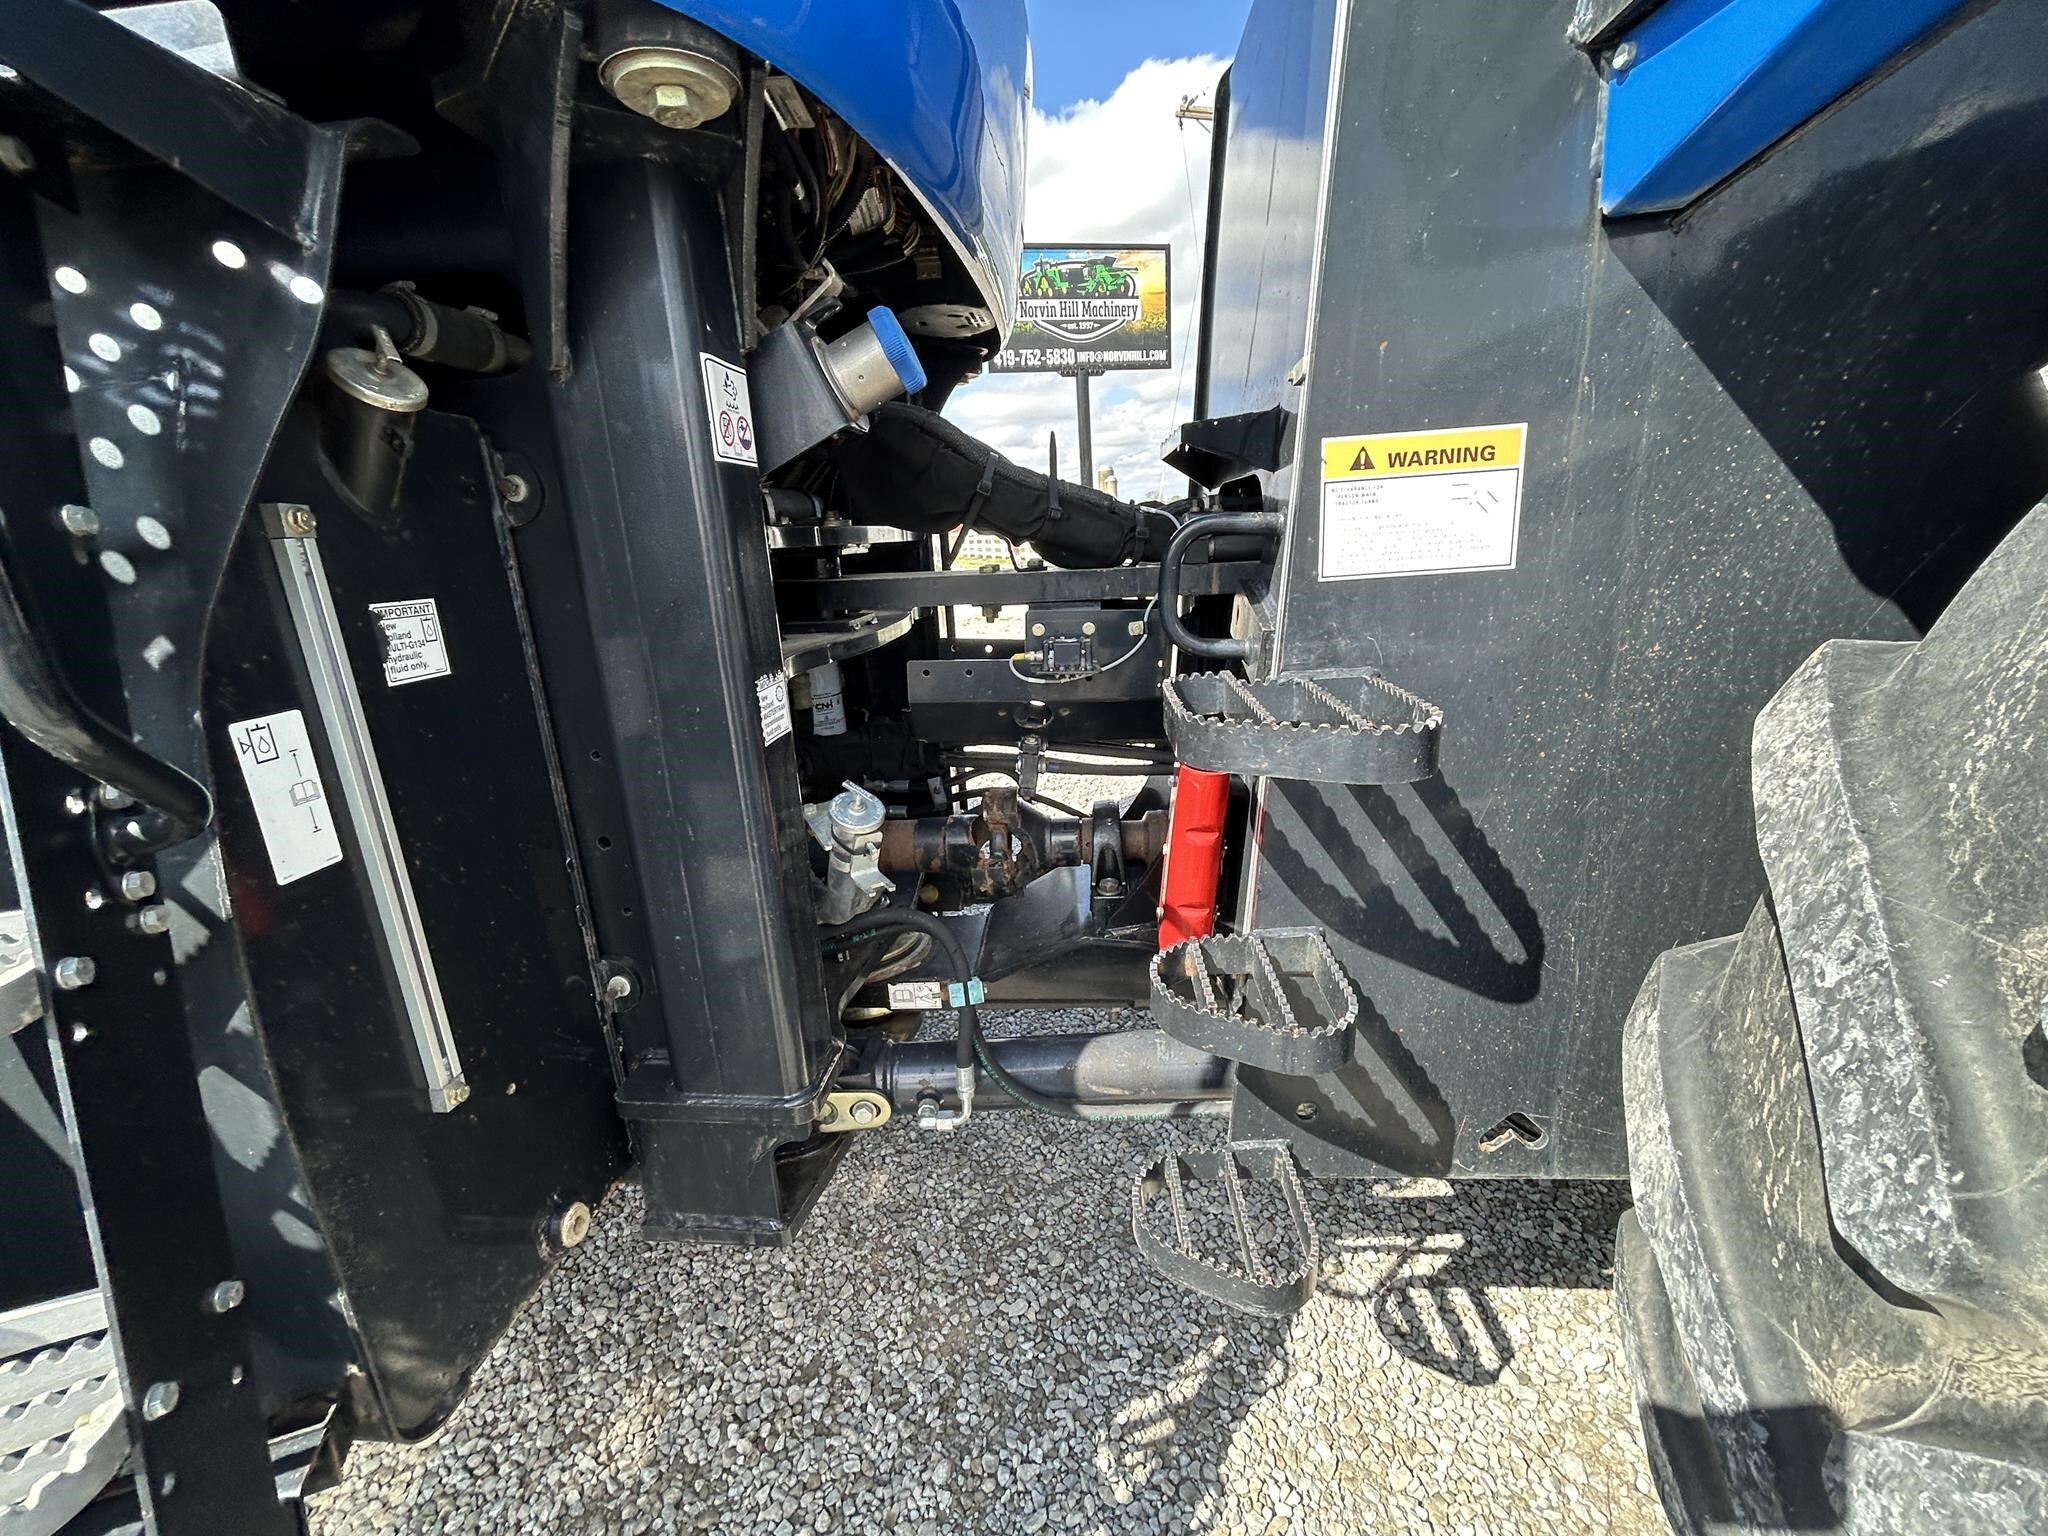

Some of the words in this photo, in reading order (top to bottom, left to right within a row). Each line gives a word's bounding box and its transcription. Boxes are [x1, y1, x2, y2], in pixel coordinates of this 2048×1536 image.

[1020, 301, 1057, 318] Norvin
[1060, 300, 1080, 318] Hill
[1082, 301, 1138, 321] Machinery
[1079, 321, 1094, 330] 1997
[1387, 445, 1496, 469] WARNING
[388, 630, 412, 641] olland
[390, 664, 409, 674] fluid
[411, 661, 430, 671] only.
